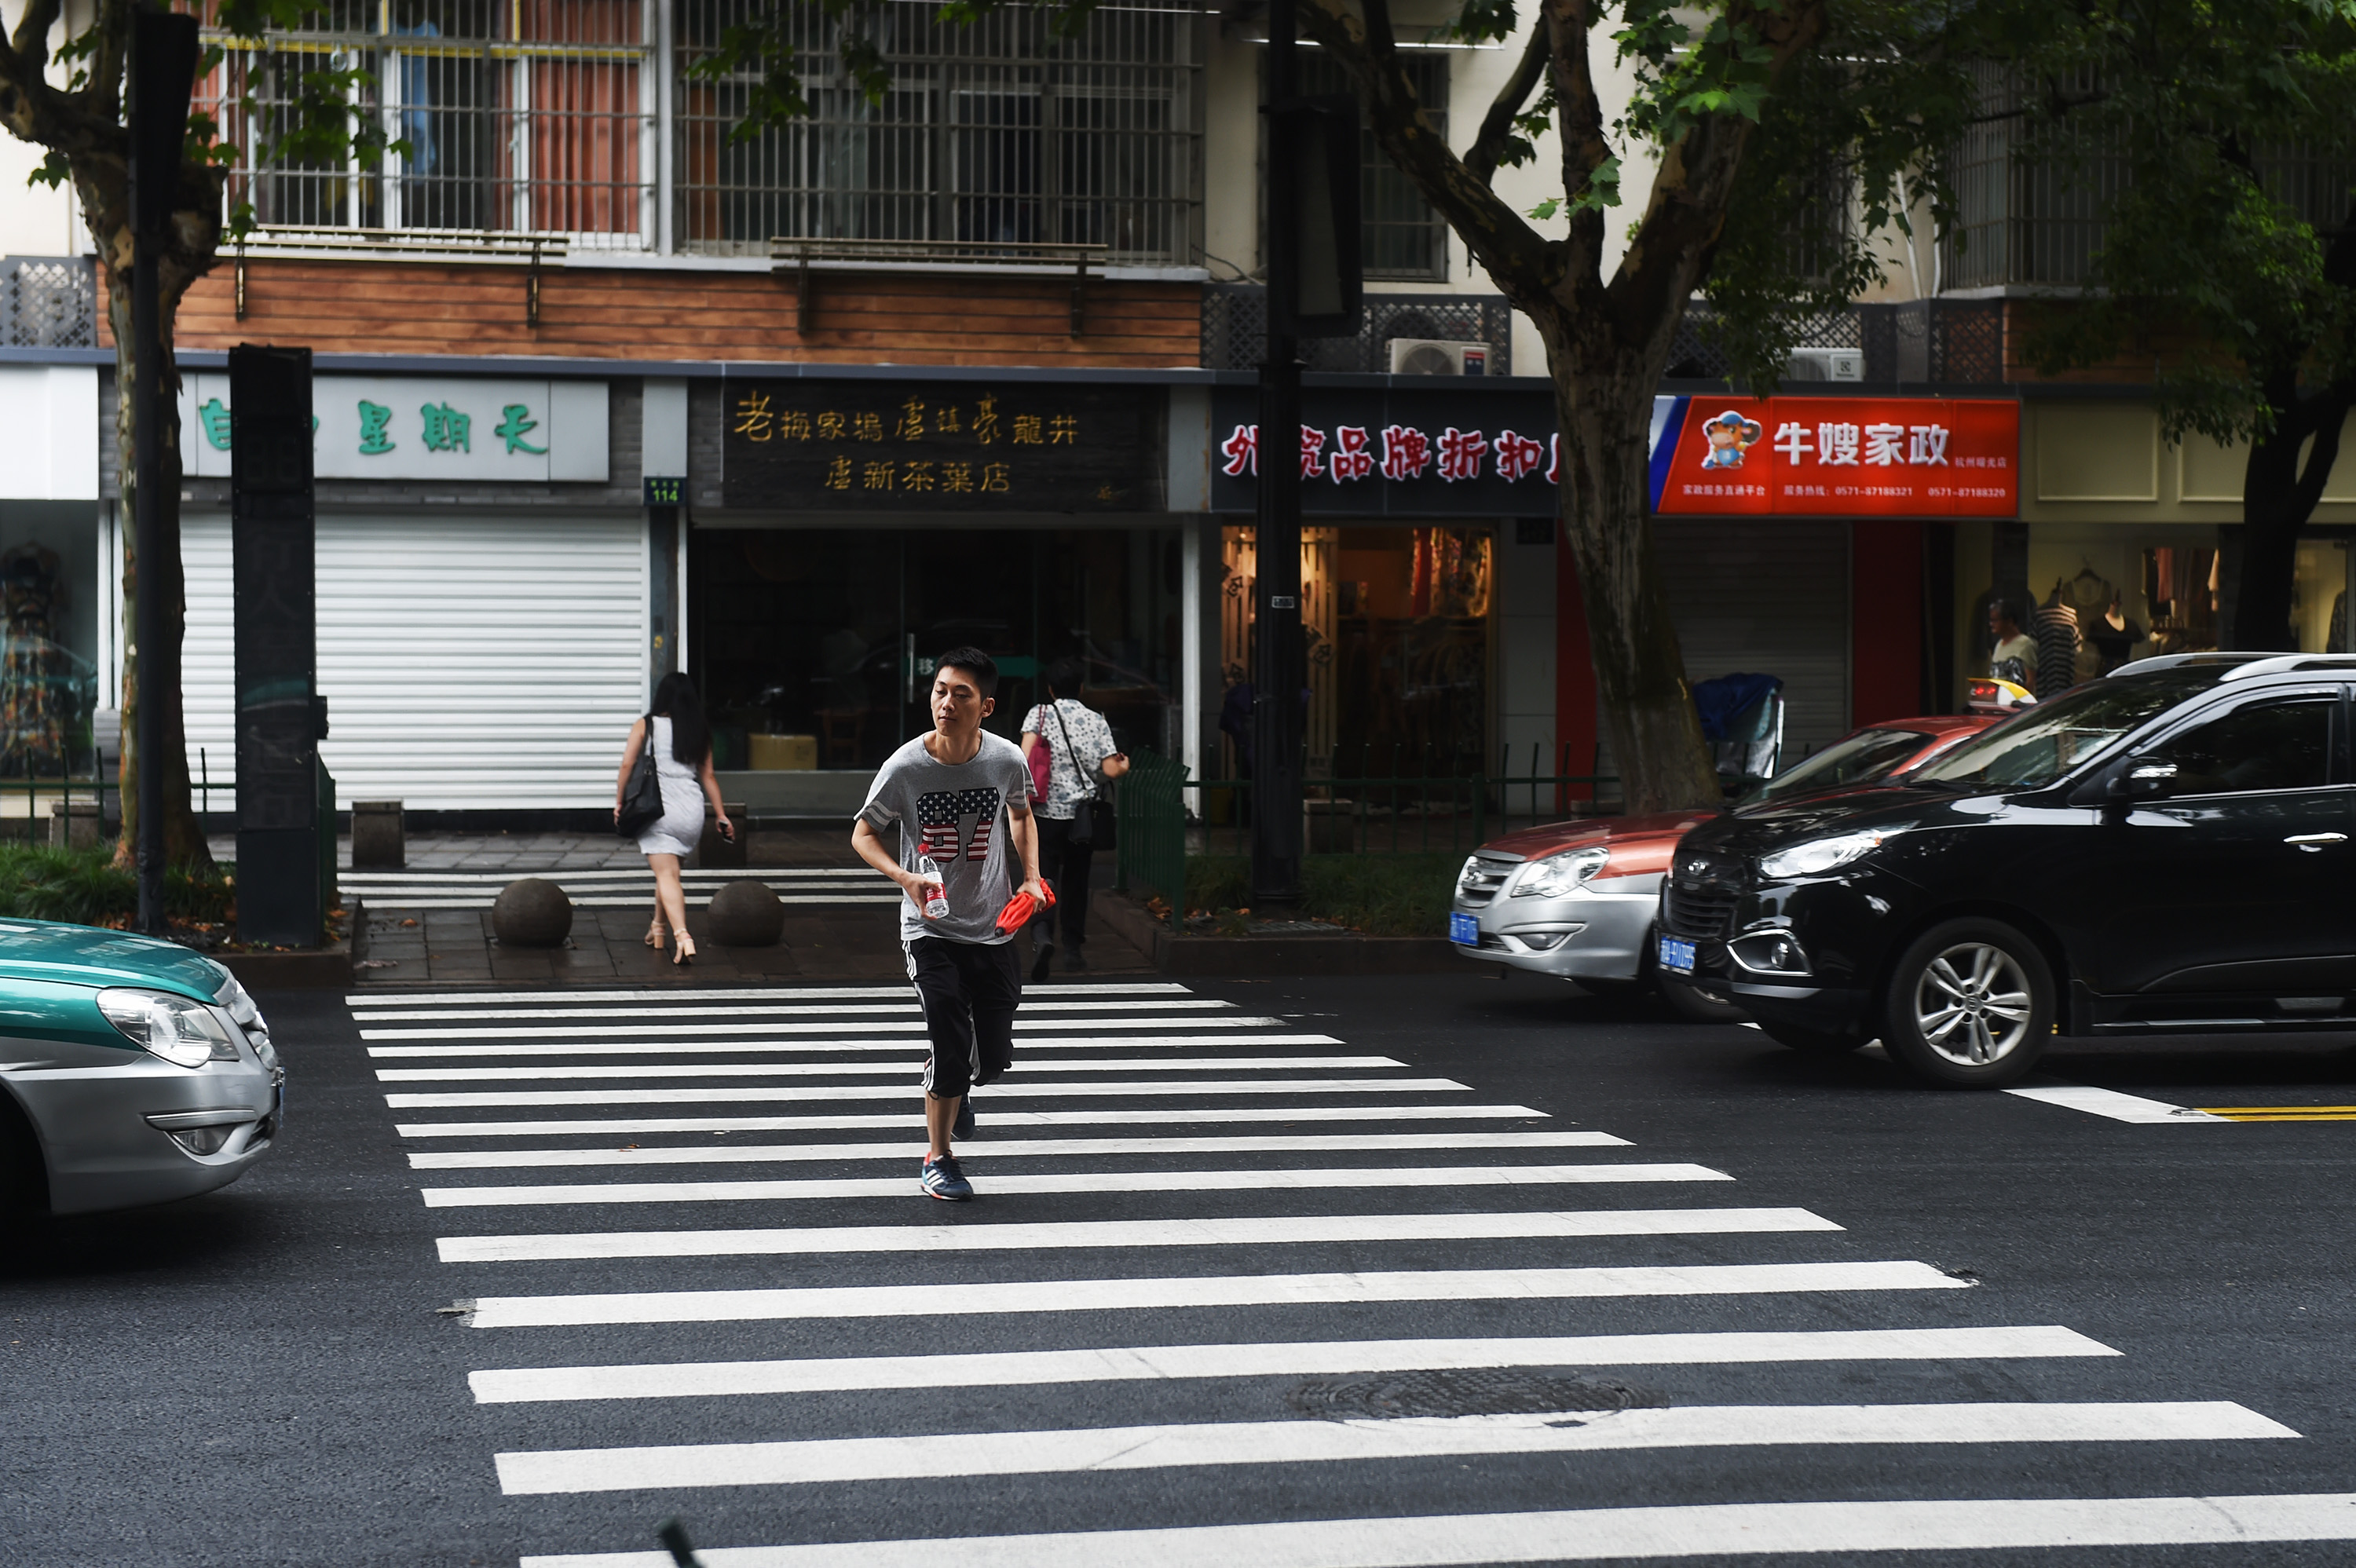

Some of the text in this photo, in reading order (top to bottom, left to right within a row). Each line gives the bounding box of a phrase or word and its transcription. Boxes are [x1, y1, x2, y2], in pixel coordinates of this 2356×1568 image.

[199, 398, 548, 455] 自星期天
[1773, 422, 1950, 467] 牛嫂家政
[1221, 423, 1560, 484] 外贸品牌折扣
[653, 488, 679, 503] 114
[1682, 484, 1766, 496] 家政服务直通平台
[1835, 485, 1913, 497] 0571-87188321
[1927, 487, 2007, 498] 0571-87188320
[916, 787, 1001, 863] 87
